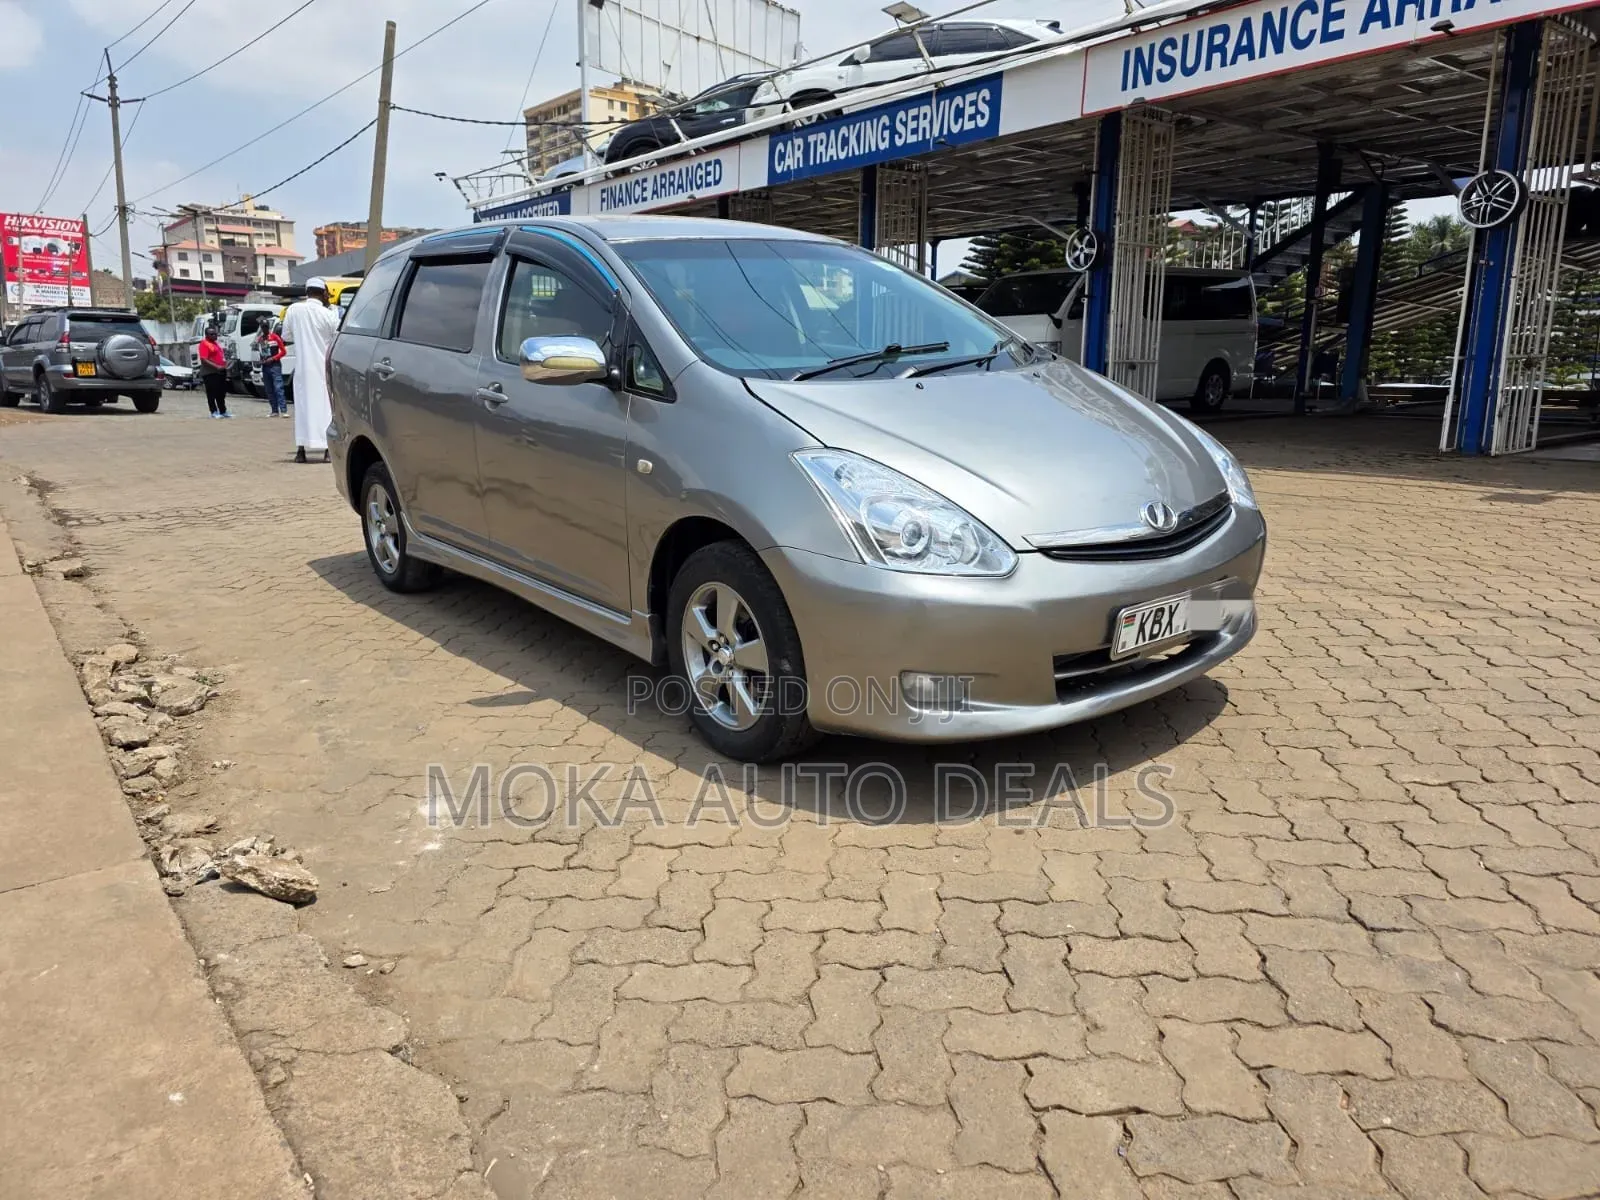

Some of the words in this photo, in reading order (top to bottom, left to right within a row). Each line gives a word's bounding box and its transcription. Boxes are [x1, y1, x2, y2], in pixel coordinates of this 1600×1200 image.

[1121, 0, 1346, 92] INSURANCE
[774, 136, 804, 174] CAR
[807, 115, 890, 166] TRACKING
[894, 88, 990, 147] SERVICES
[600, 177, 648, 212] FINANCE
[651, 158, 722, 201] ARRANGED
[4, 215, 82, 232] HIKVISION
